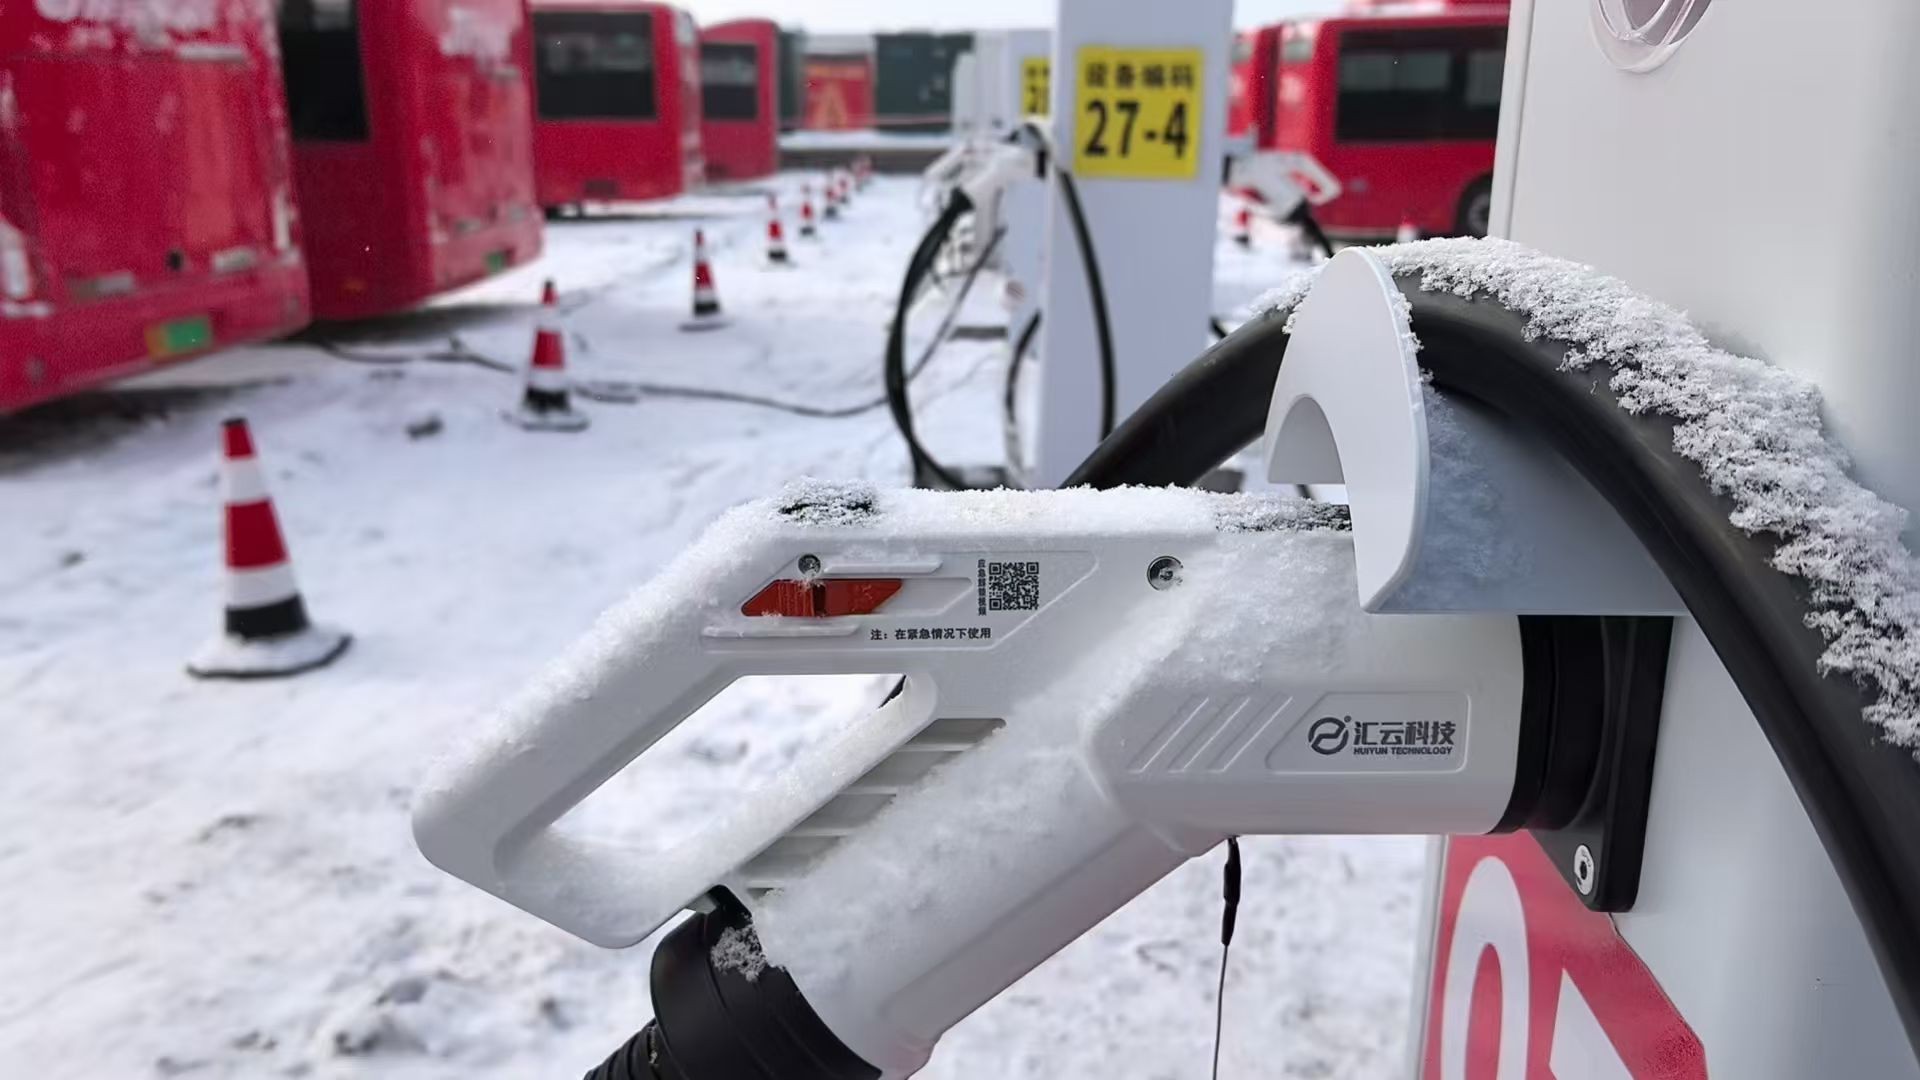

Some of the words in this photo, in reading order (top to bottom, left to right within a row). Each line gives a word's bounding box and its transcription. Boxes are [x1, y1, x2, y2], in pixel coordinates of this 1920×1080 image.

[1084, 99, 1189, 159] 27-4
[1353, 721, 1456, 745] 汇云科技
[1353, 747, 1388, 755] HUIYUN
[1391, 747, 1453, 755] TECHNOLOGY
